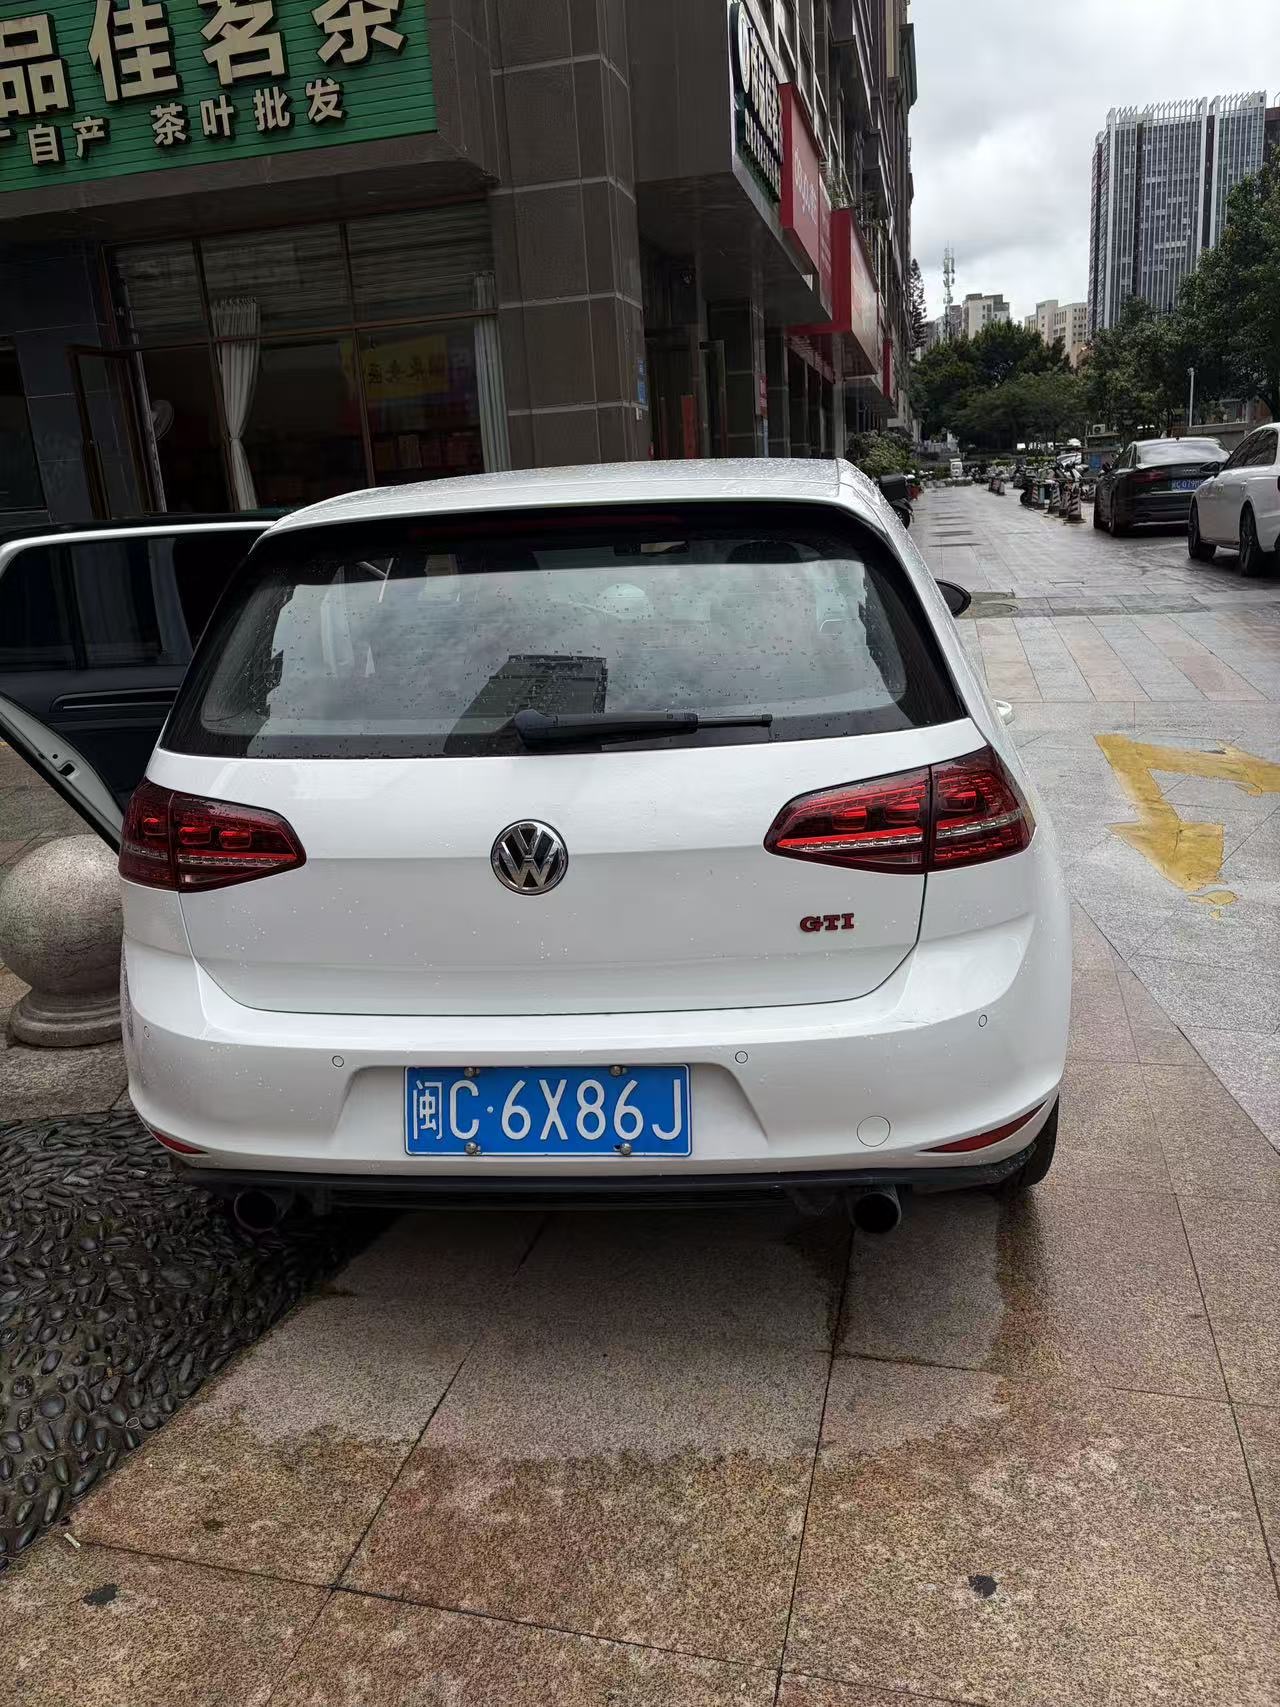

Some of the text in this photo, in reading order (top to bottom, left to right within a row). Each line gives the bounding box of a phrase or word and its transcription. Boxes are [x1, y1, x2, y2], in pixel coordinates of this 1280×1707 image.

[150, 77, 344, 146] 茶叶批发
[799, 912, 855, 932] GTI
